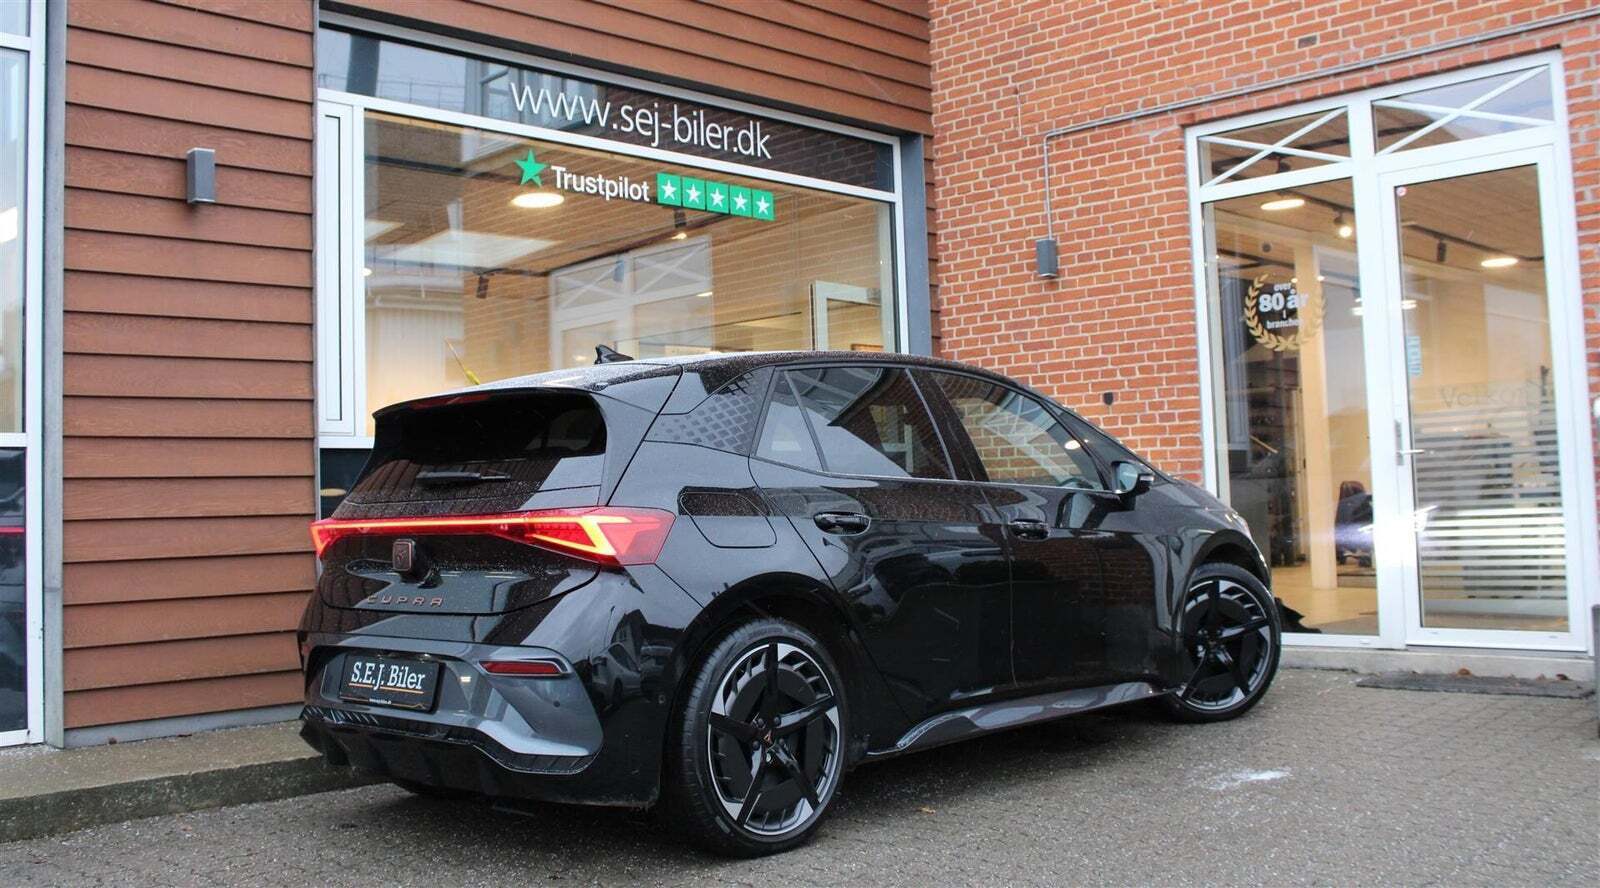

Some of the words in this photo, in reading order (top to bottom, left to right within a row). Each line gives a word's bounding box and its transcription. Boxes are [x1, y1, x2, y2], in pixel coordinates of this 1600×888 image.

[510, 82, 772, 159] www.sej-biler.dk
[551, 165, 650, 202] Trustpilot
[1258, 292, 1284, 312] 80
[367, 595, 443, 608] CUPRA
[350, 661, 385, 691] S.E.J.
[386, 664, 426, 690] Biler
